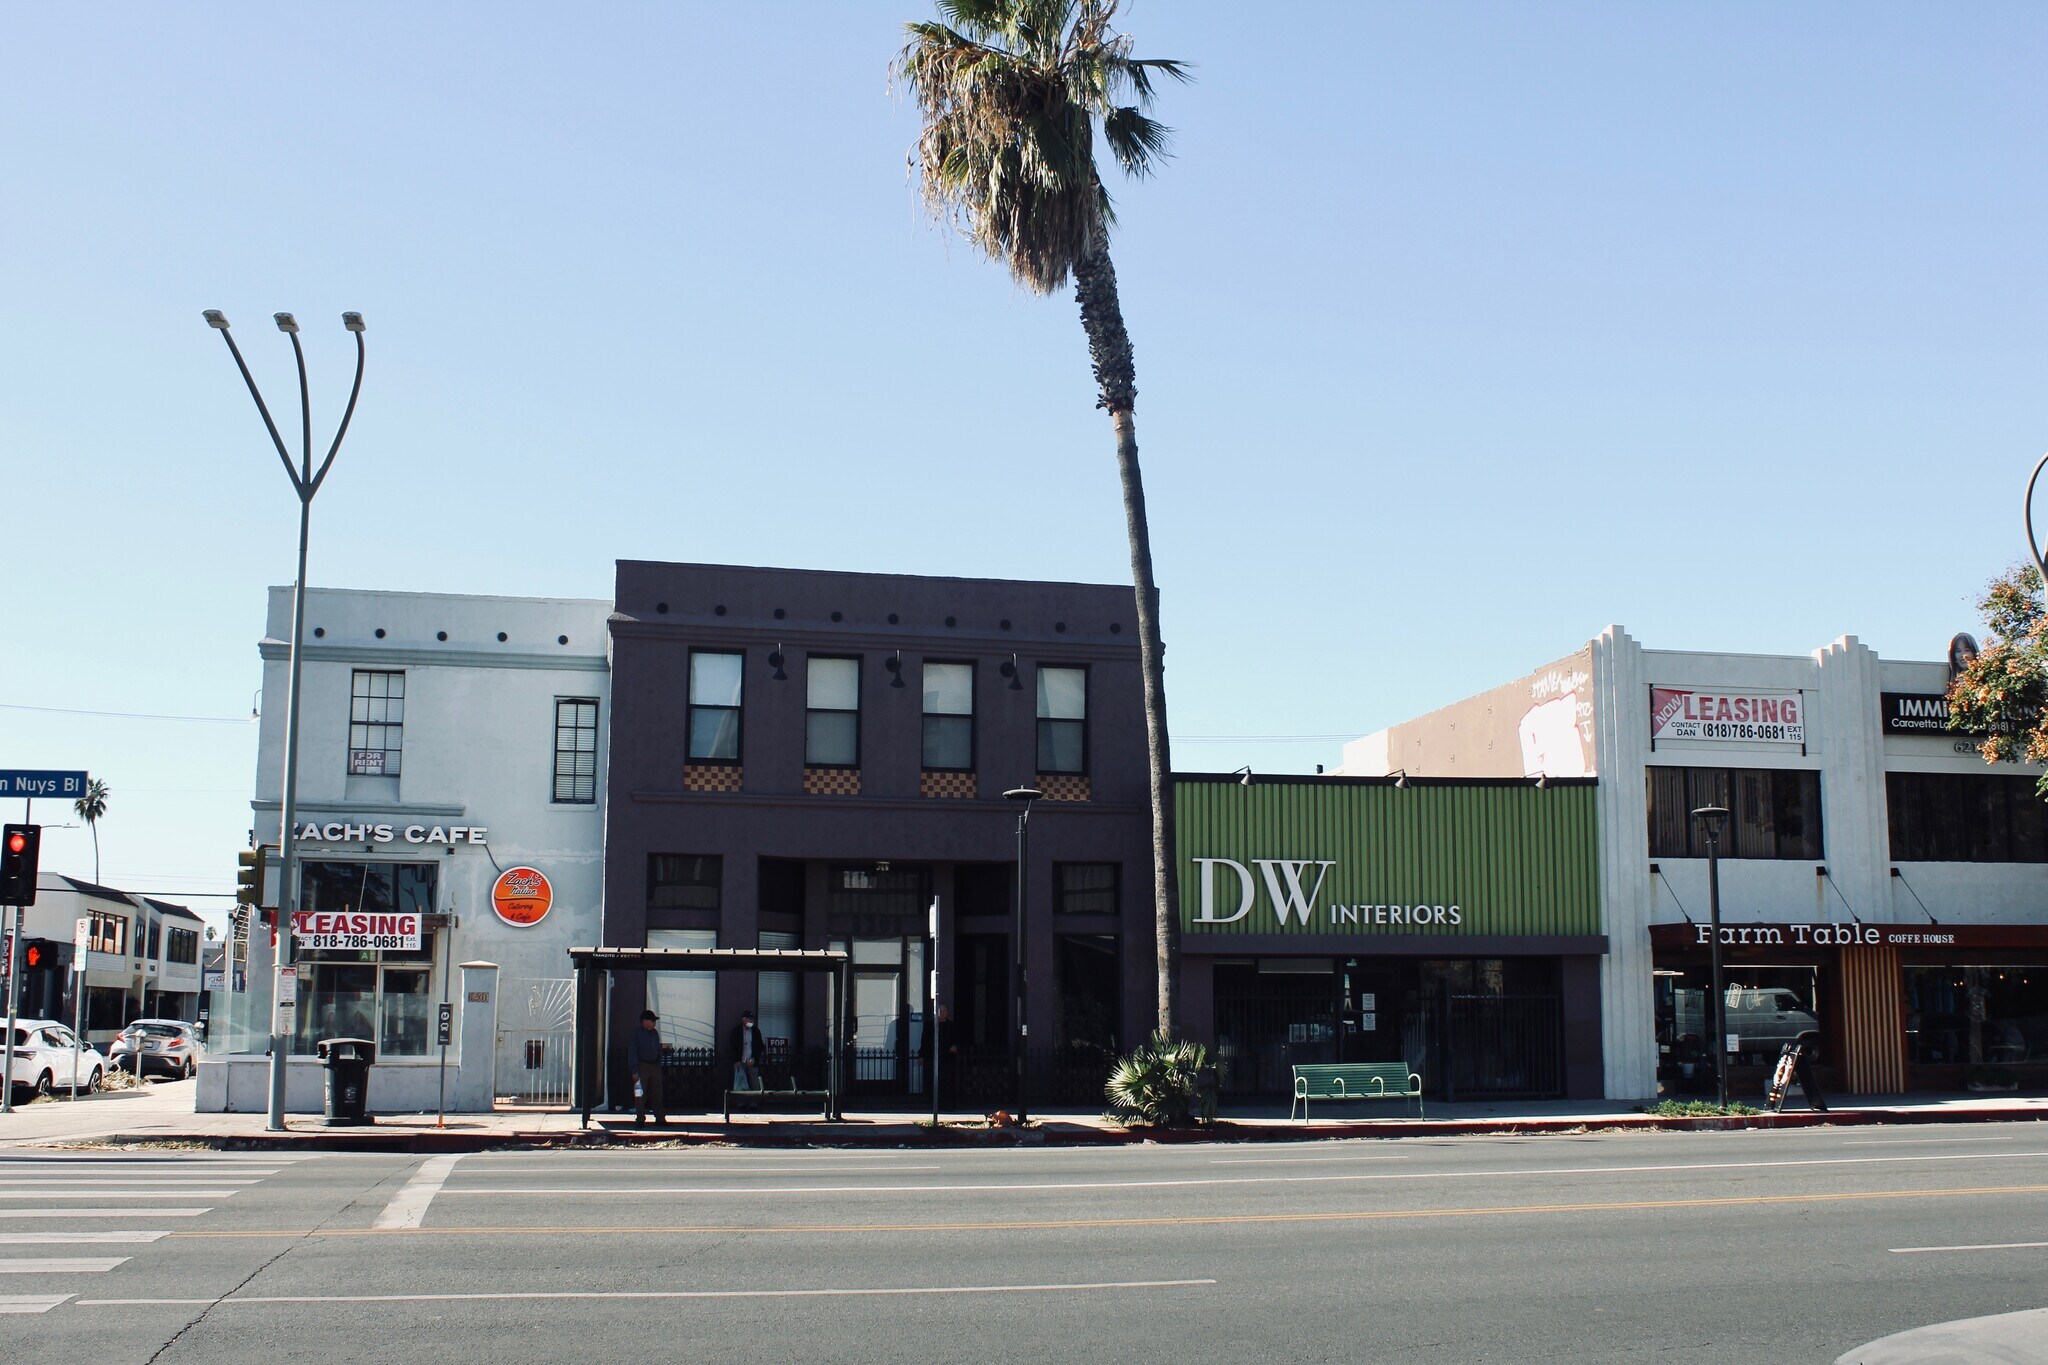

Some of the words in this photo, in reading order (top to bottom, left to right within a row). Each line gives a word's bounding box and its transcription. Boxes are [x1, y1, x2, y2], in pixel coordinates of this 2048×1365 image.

[1655, 694, 1682, 726] NOW
[1684, 695, 1797, 724] LEASING
[1677, 728, 1696, 736] DAN
[1703, 723, 1785, 740] (818)786-0681
[1891, 718, 1938, 729] Caravetta
[359, 752, 380, 760] FOR
[16, 776, 56, 795] Nuys
[64, 777, 79, 791] Bl
[404, 825, 489, 845] CAFE
[504, 872, 543, 886] Zach's
[509, 885, 538, 896] Italian
[1192, 857, 1336, 926] DW
[1330, 904, 1462, 926] INTERIORS
[300, 913, 417, 936] LEASING
[313, 934, 405, 949] 818-786-0681
[1695, 923, 1784, 944] Farm
[1790, 922, 1880, 945] Table
[1888, 934, 1921, 944] COFFE
[1923, 934, 1955, 944] HOUSE
[361, 951, 369, 960] A
